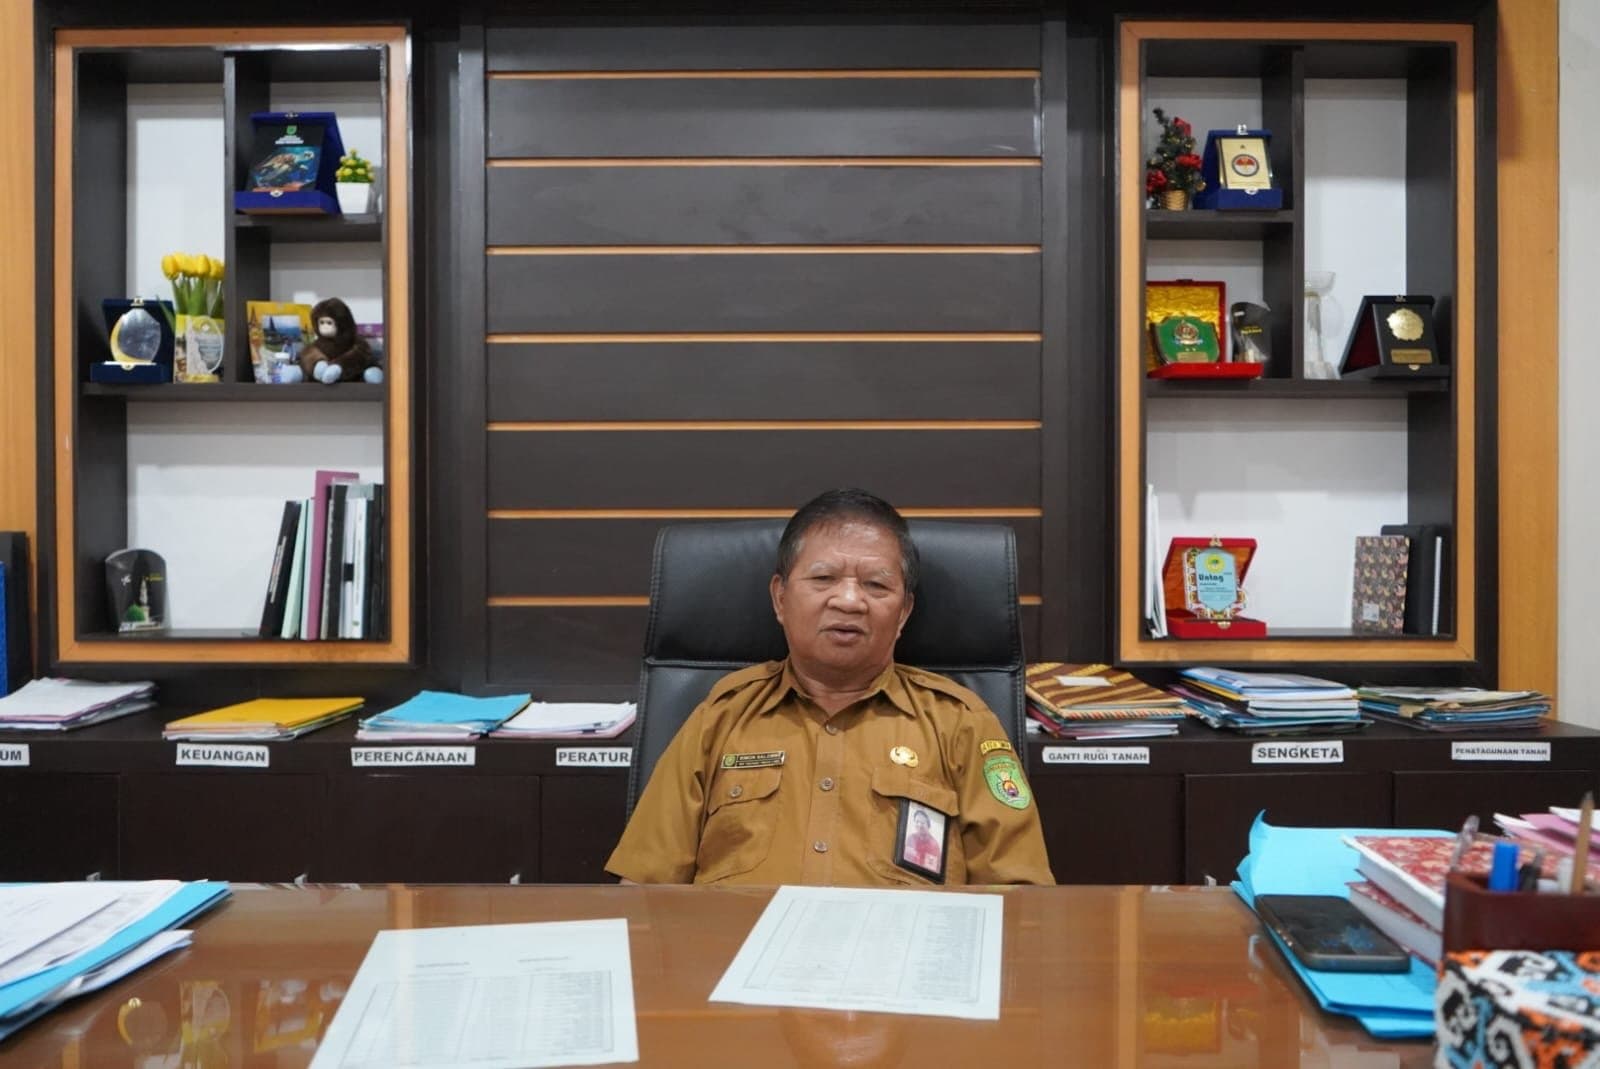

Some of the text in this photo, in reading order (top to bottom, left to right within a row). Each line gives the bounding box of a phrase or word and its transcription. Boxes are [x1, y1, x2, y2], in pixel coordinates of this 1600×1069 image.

[181, 749, 266, 762] KEUANGAN
[354, 751, 467, 762] PERENCANAAN
[558, 751, 629, 762] PERATUR
[1048, 752, 1147, 761] GANTI RUGI TANAH
[1257, 747, 1340, 759] SENGKETA
